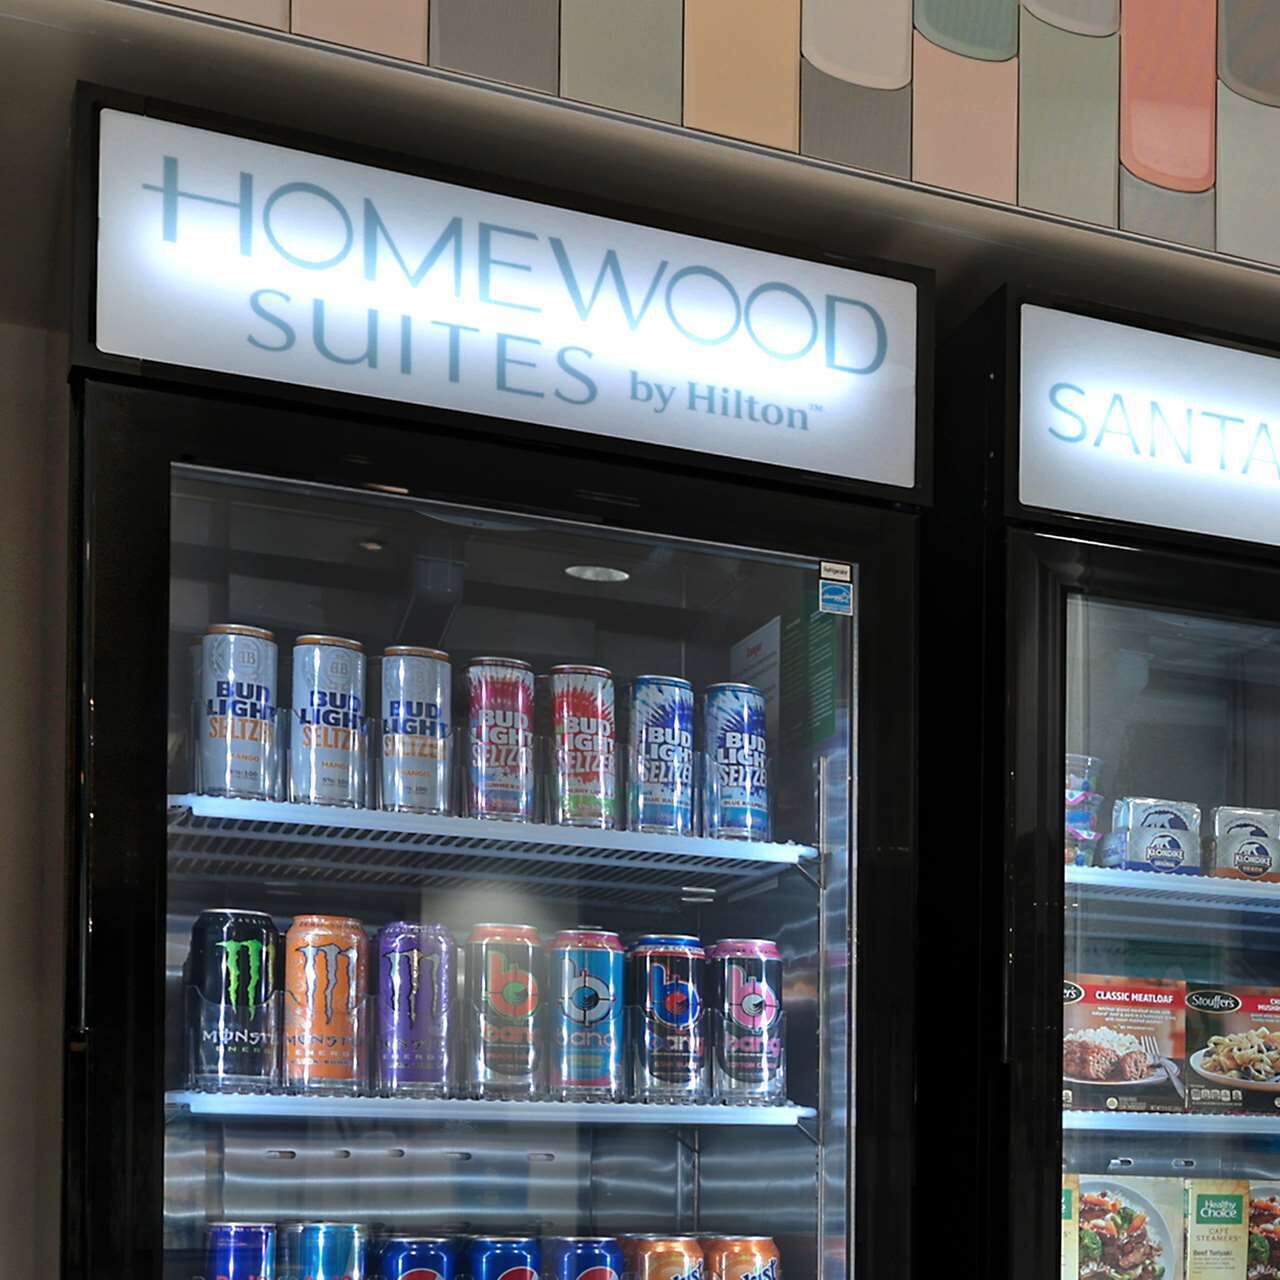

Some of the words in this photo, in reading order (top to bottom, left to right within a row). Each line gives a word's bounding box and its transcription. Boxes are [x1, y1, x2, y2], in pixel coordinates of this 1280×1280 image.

[142, 155, 889, 376] HOMEWOOD
[247, 288, 598, 406] SUITES
[629, 372, 678, 414] by
[217, 681, 270, 704] BUD
[310, 691, 362, 712] BUD
[207, 699, 277, 723] LIGHT
[300, 708, 366, 731] LIGHT
[390, 701, 442, 718] BUD
[478, 710, 528, 729] BUD
[384, 719, 448, 738] LIGHT
[471, 727, 533, 747] LIGHT
[568, 717, 611, 737] BUD
[650, 727, 692, 747] BUD
[556, 733, 614, 753] LIGHT
[725, 732, 766, 752] BUD
[1146, 848, 1185, 861] KLONDIKE
[1234, 854, 1273, 867] KLONDIKE
[1096, 991, 1130, 1002] CLASSIC
[1131, 993, 1174, 1004] MEATLOAF
[1191, 994, 1236, 1012] Stouffer's
[1200, 1207, 1237, 1218] Choice
[1205, 1199, 1237, 1212] Healthy
